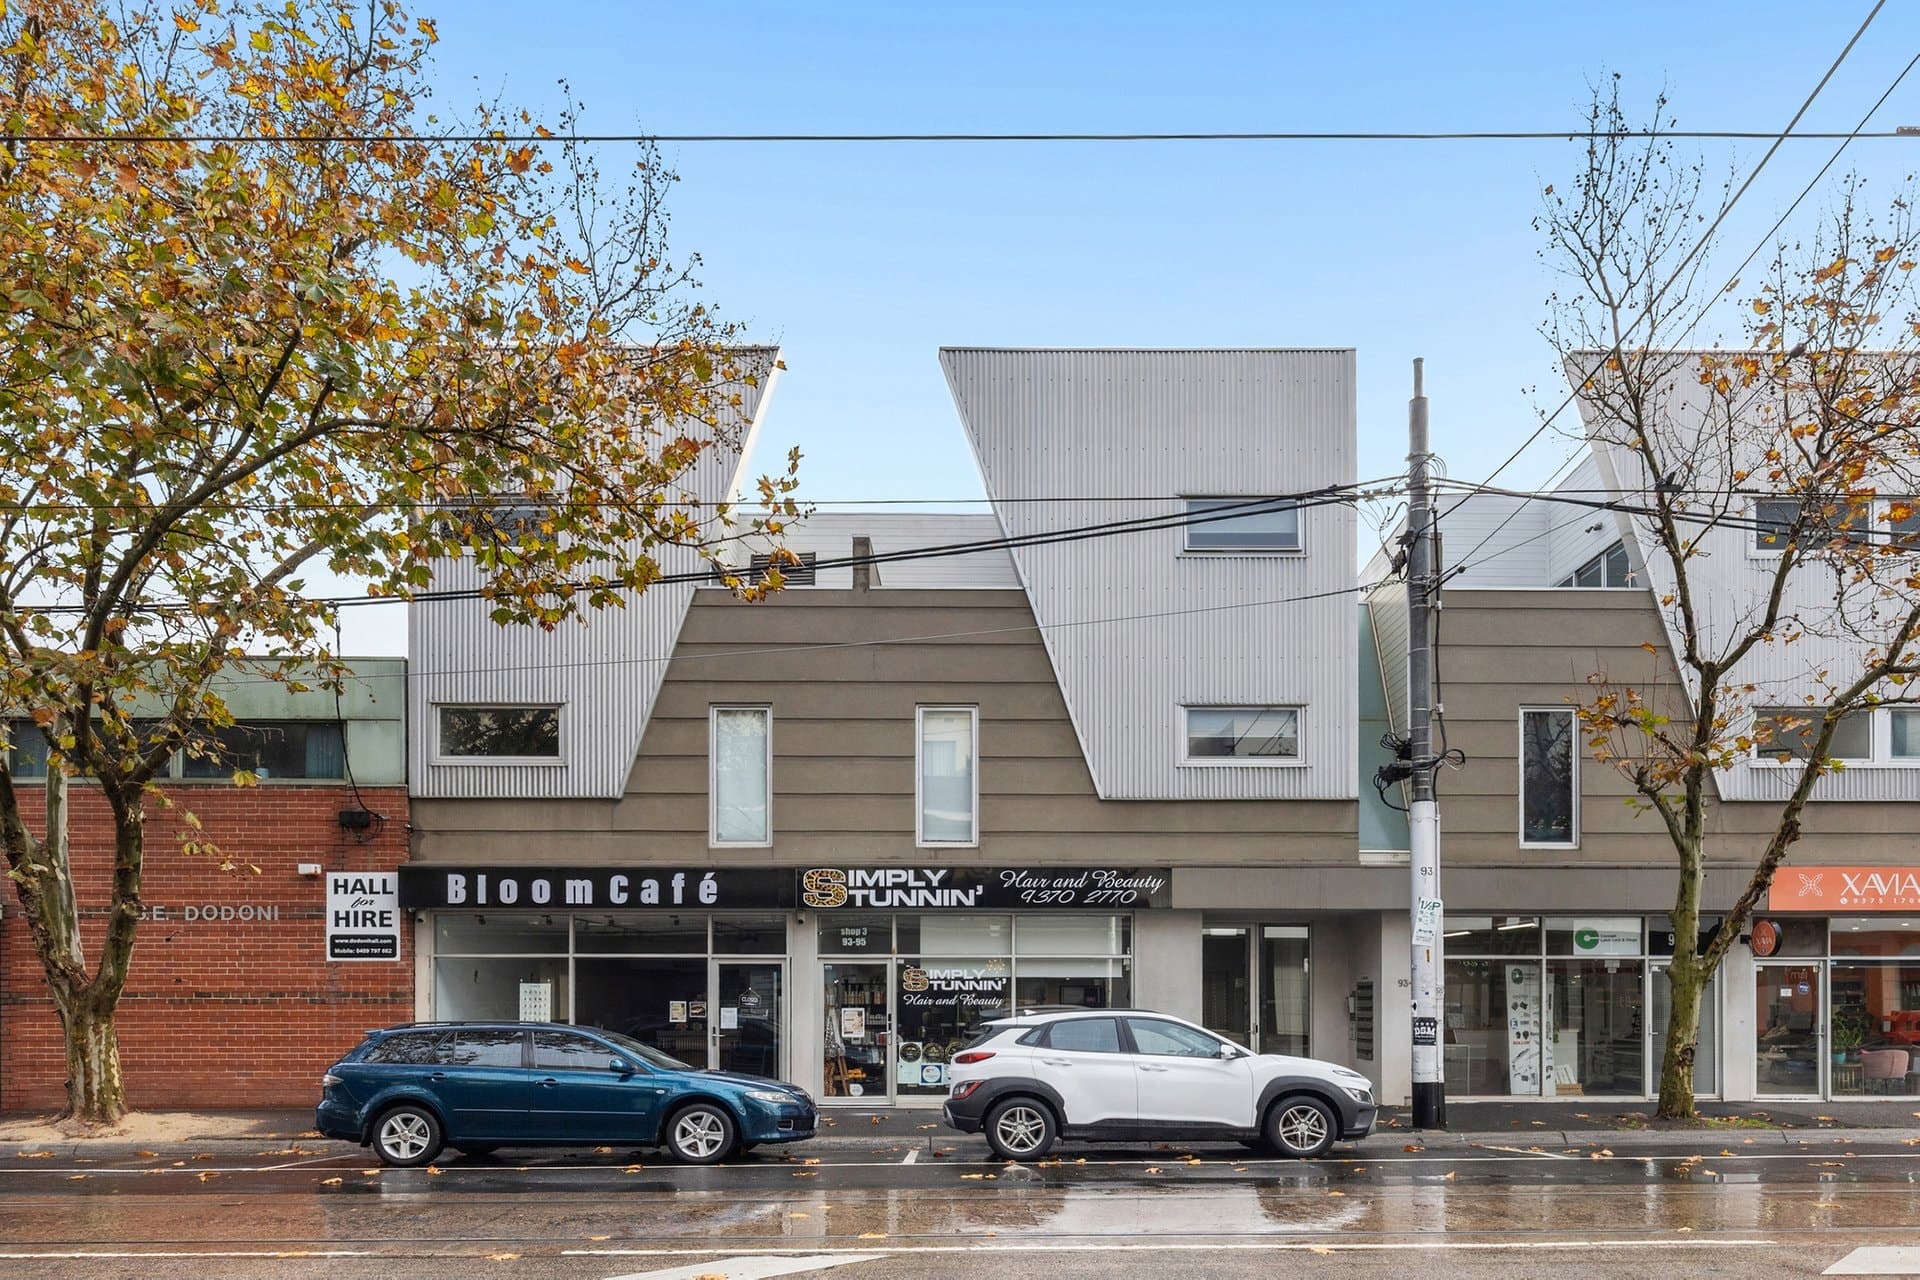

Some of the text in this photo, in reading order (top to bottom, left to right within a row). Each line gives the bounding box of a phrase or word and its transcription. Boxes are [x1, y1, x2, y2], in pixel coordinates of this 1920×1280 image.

[1420, 866, 1433, 876] 93
[333, 878, 394, 895] HALL
[447, 872, 718, 904] Bloom Café
[1000, 870, 1166, 894] Hair and Beauty
[1840, 873, 1920, 896] XAVIA
[351, 897, 375, 908] for
[1021, 889, 1137, 904] 9370 2770
[184, 904, 279, 921] DODONI
[334, 910, 393, 928] HIRE
[840, 927, 868, 936] shop 3
[842, 937, 867, 946] 93-95
[903, 994, 1003, 1008] Hair and Beauty
